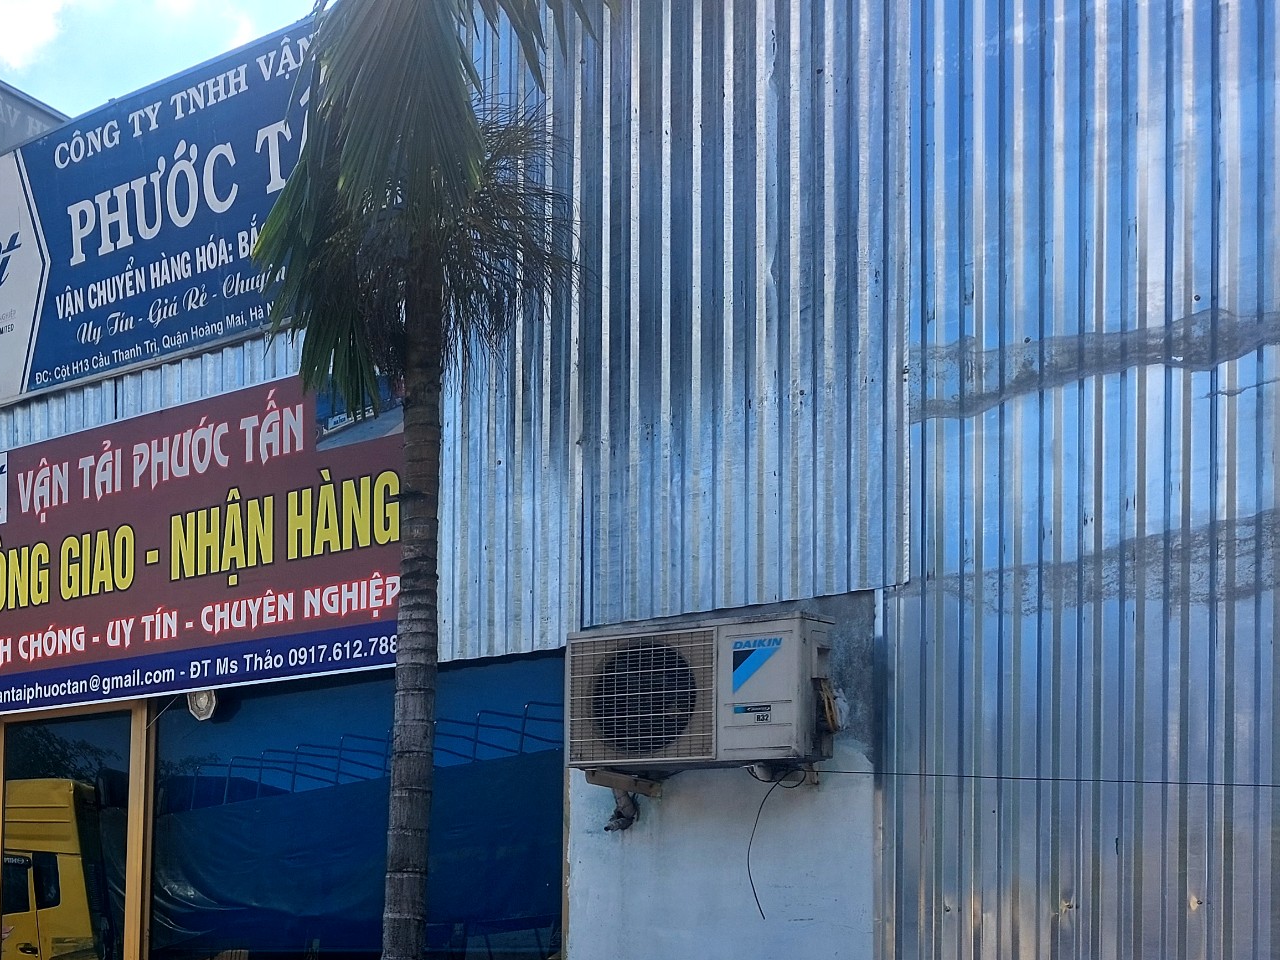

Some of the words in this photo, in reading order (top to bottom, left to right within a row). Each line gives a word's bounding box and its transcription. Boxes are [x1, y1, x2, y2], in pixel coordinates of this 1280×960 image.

[54, 120, 120, 169] CÔNG
[128, 100, 162, 138] TY
[170, 63, 248, 121] TNHH
[67, 139, 239, 266] PHƯỚC
[55, 285, 84, 322] VẬN
[87, 256, 146, 310] CHUYỂN
[149, 252, 191, 289] HÀNG
[195, 233, 233, 273] HÓA:
[77, 322, 103, 345] Uy
[106, 310, 136, 336] Tín
[146, 298, 178, 329] Giá
[182, 284, 209, 312] Rẻ
[222, 263, 287, 299] Chuyn
[35, 369, 52, 385] ĐC:
[54, 363, 71, 381] Cột
[72, 356, 91, 375] H13
[91, 350, 110, 370] Cầu
[112, 342, 142, 364] Thanh
[144, 337, 160, 354] Trì,
[162, 330, 189, 353] Quận
[190, 320, 224, 343] Hoàng
[226, 310, 248, 332] Mai,
[249, 306, 264, 323] Hà
[17, 456, 69, 524] VẬN
[78, 439, 122, 501] TẢI
[132, 415, 230, 490] PHƯỚC
[239, 389, 305, 466] TẤN
[59, 525, 135, 602] GIAO
[169, 487, 274, 587] NHẬN
[286, 468, 401, 561] HÀNG
[18, 623, 85, 662] CHÓNG
[107, 620, 133, 649] UY
[134, 606, 178, 643] TÍN
[200, 589, 294, 635] CHUYÊN
[303, 571, 401, 619] NGHIỆP
[189, 659, 212, 680] ĐT
[215, 654, 239, 676] Ms
[243, 646, 284, 672] Thảo
[287, 633, 398, 666] 0917.612.788
[732, 637, 783, 650] DAIKIN
[756, 713, 770, 722] R32
